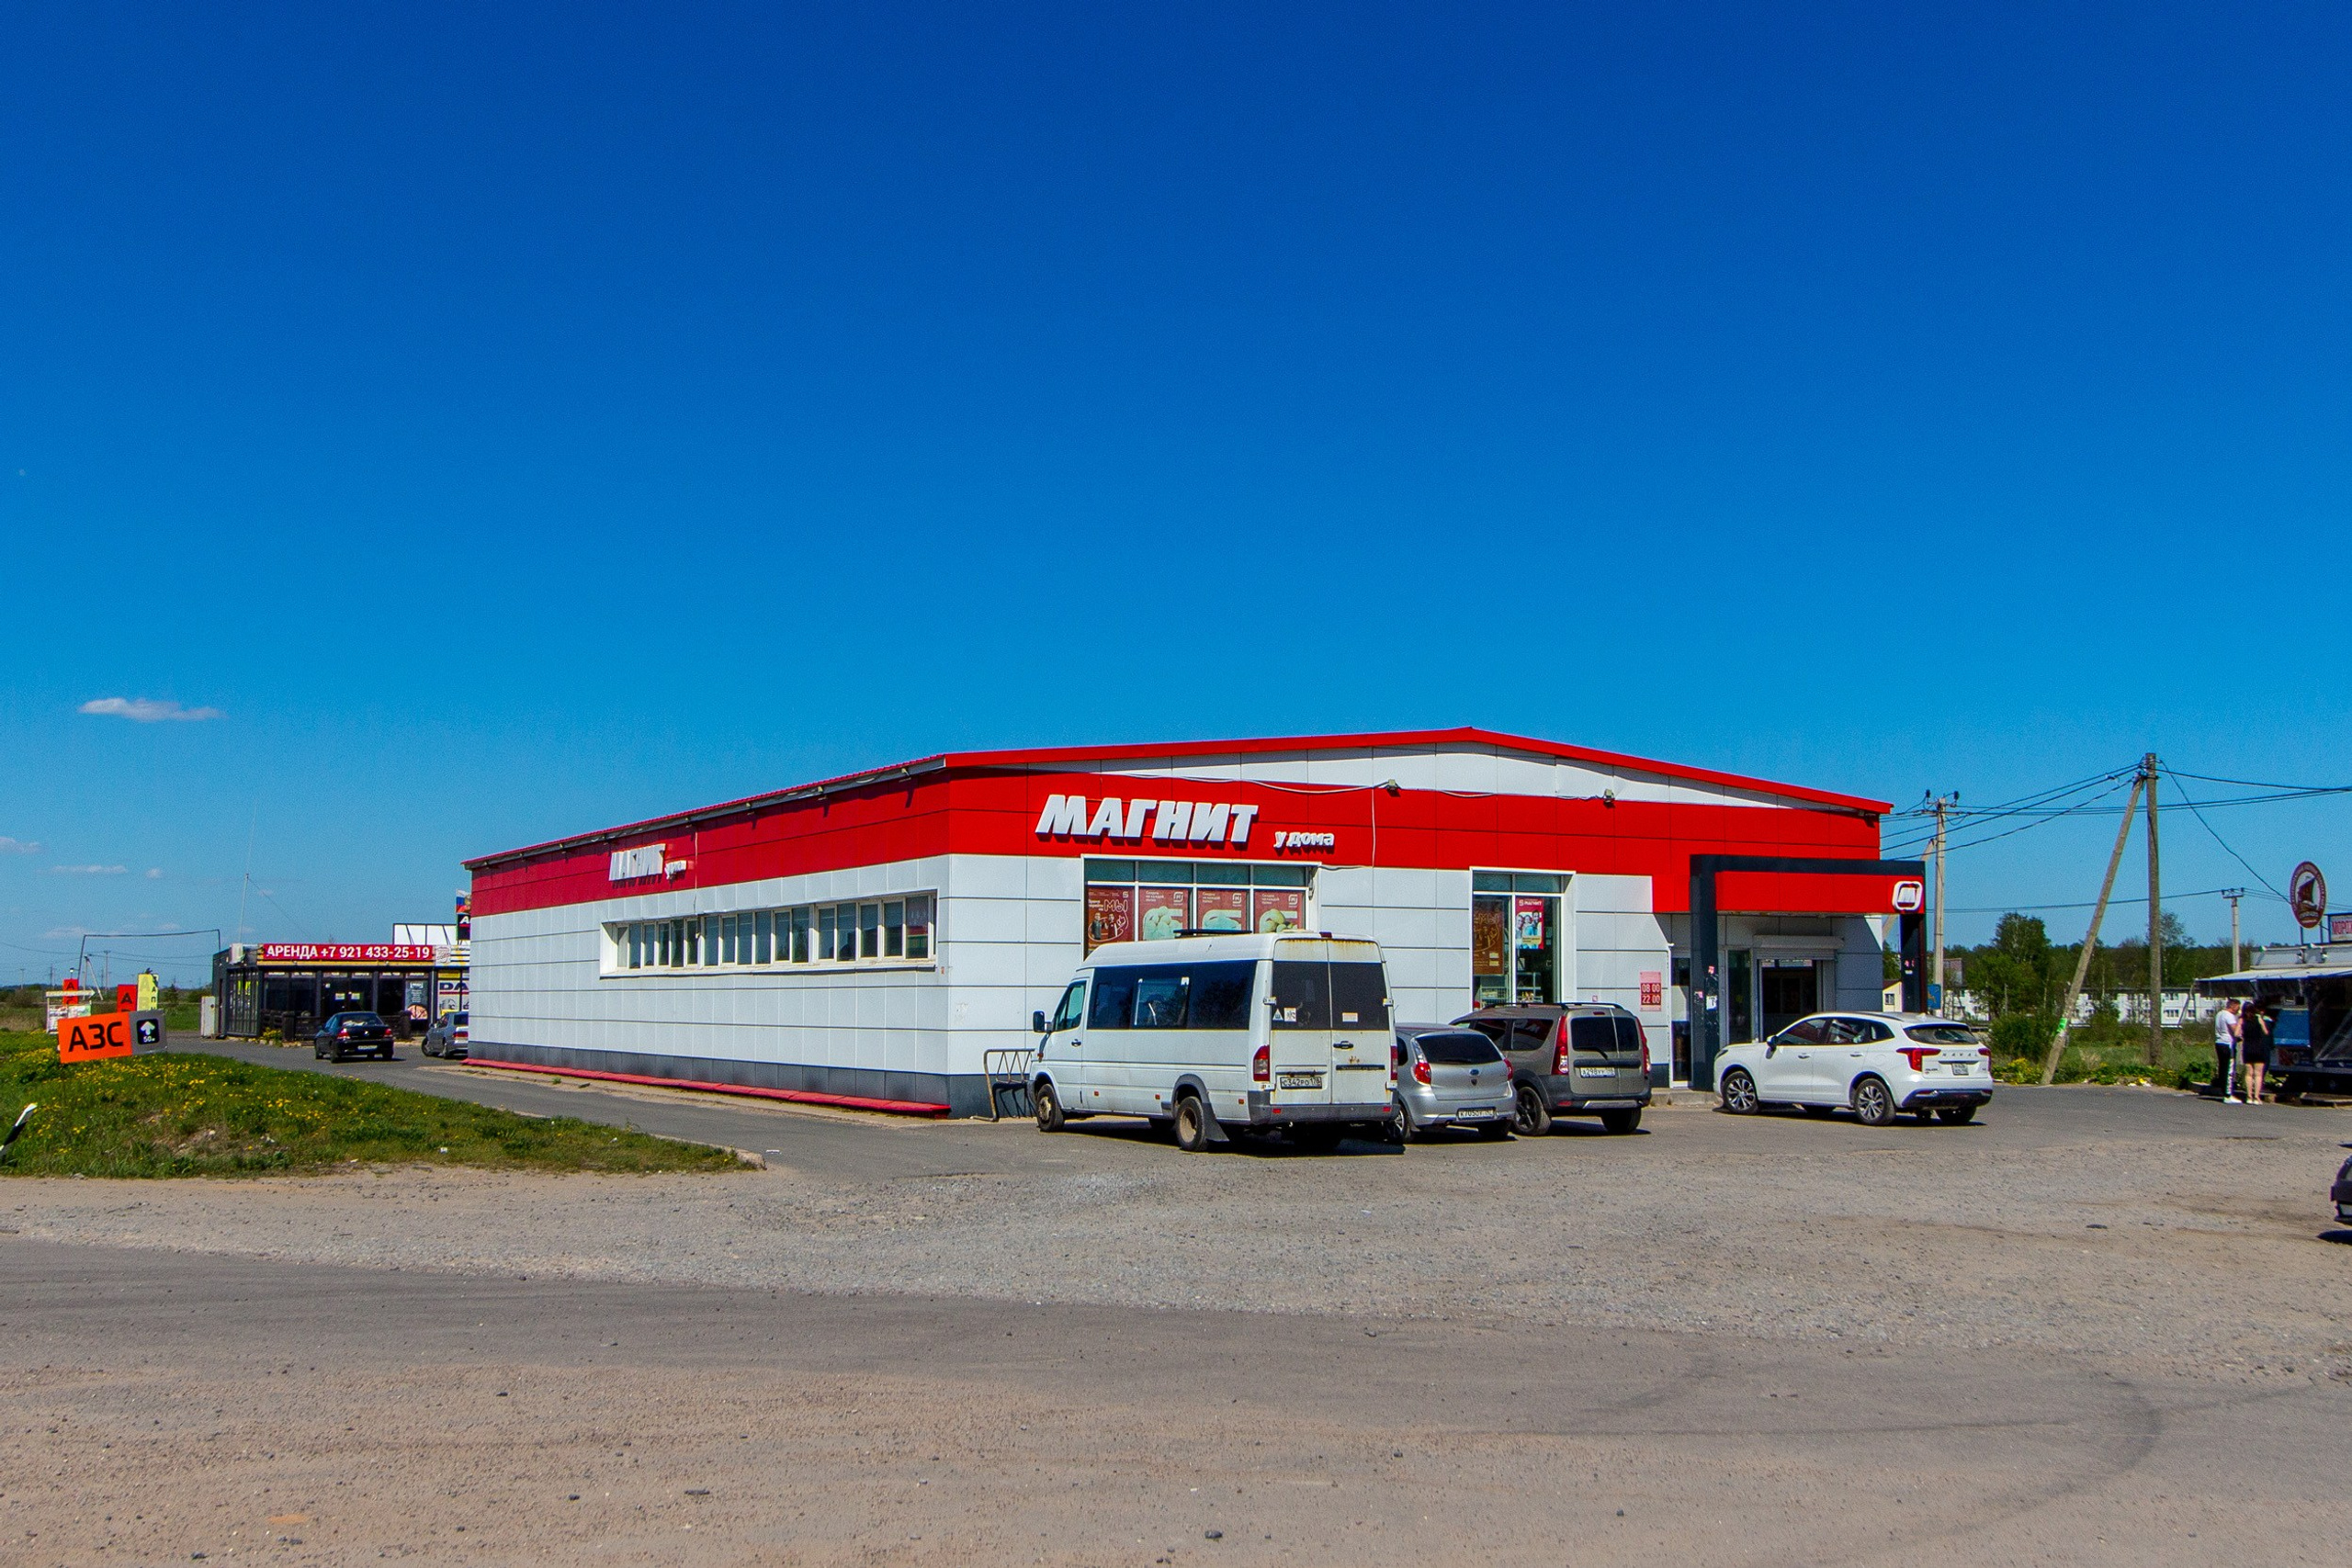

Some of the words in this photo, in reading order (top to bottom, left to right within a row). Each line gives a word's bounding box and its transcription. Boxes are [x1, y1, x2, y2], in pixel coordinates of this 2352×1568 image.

[1035, 795, 1259, 842] МАГНИТ
[1272, 830, 1286, 849] у
[1286, 830, 1335, 848] дома
[266, 945, 318, 960] АРЕНДА
[321, 946, 336, 957] +7
[339, 946, 362, 958] 921
[365, 946, 430, 959] 433-25-19
[1652, 984, 1660, 992] 00
[1642, 995, 1651, 1004] 22
[1652, 995, 1660, 1004] 00
[68, 1021, 124, 1053] АЗС
